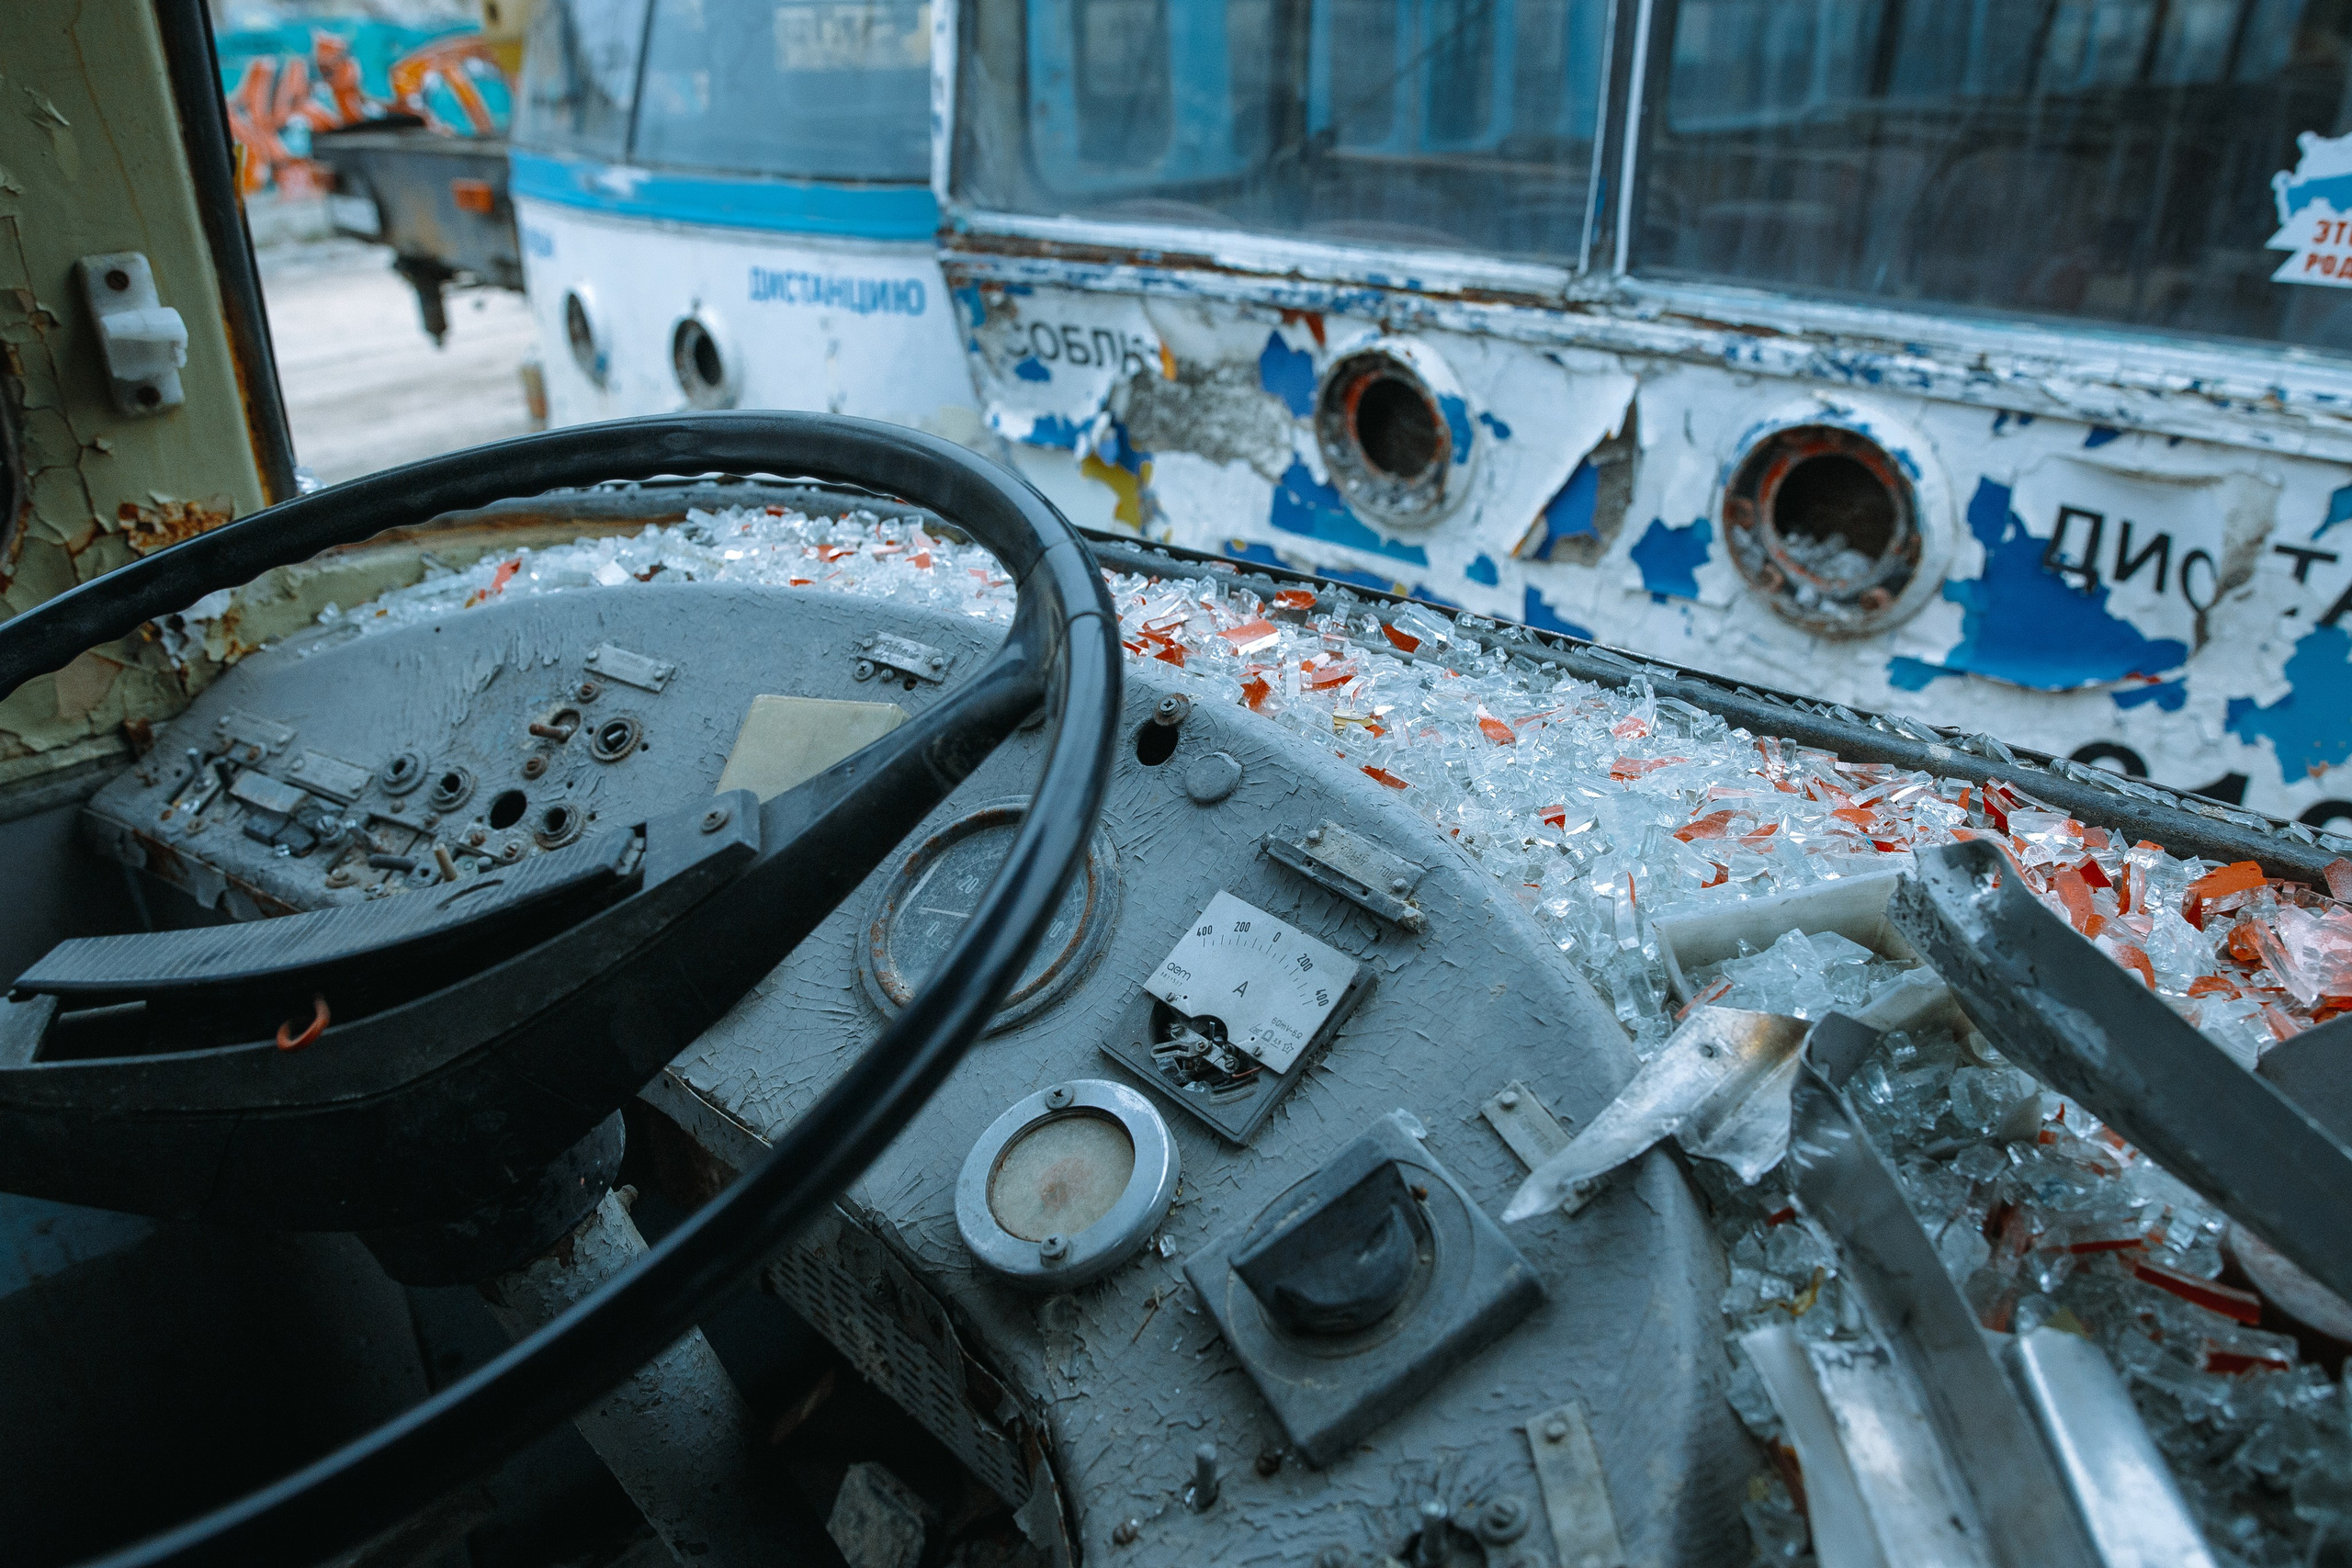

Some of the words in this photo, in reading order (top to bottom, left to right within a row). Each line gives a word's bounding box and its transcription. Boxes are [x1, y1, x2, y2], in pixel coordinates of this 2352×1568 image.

[2312, 220, 2352, 246] ЭТ
[958, 874, 979, 894] 20
[1197, 925, 1213, 937] 400
[1234, 921, 1250, 932] 200
[1272, 931, 1282, 942] 0
[1167, 962, 1192, 981] aem
[1296, 953, 1313, 972] 200
[1232, 980, 1249, 998] A
[1315, 988, 1329, 1007] 400
